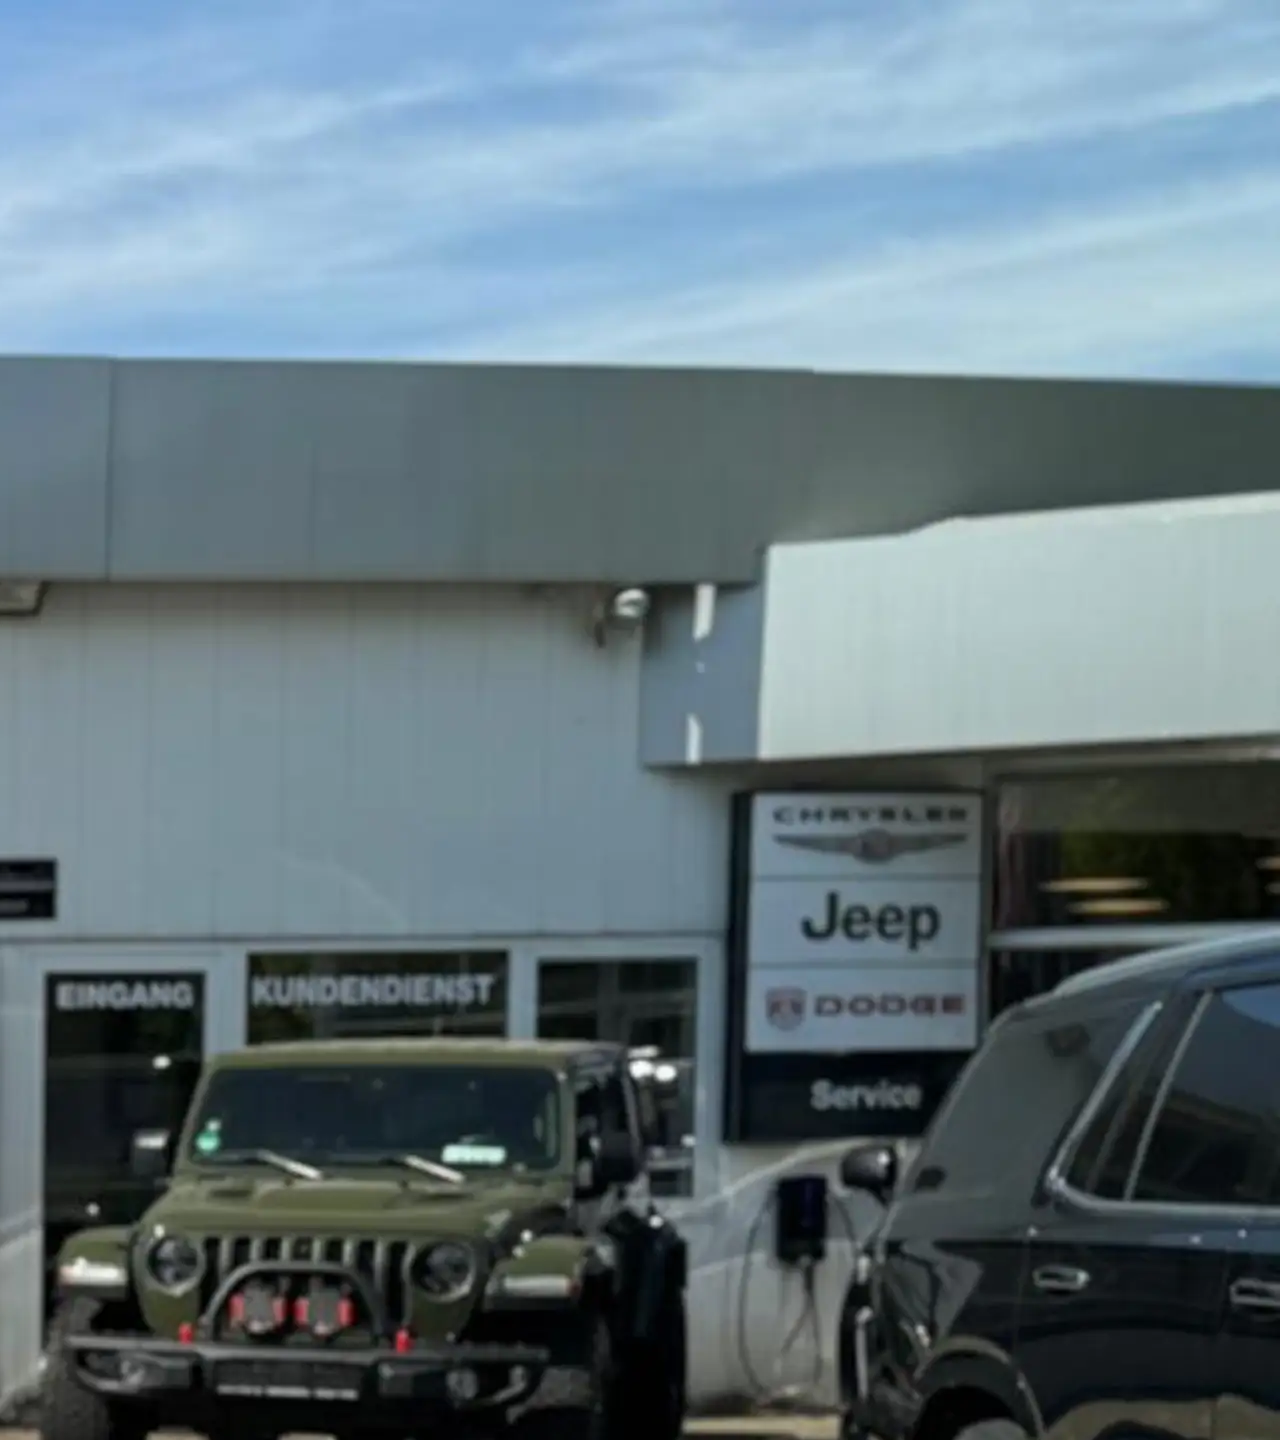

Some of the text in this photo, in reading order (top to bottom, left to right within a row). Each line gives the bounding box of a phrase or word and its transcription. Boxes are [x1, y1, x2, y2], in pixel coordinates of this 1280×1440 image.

[771, 805, 968, 826] CHRYSLER
[800, 890, 942, 953] Jeep
[55, 980, 194, 1011] EINGANG
[251, 973, 496, 1007] KUNDENDIENST
[812, 993, 967, 1018] DODGE
[809, 1078, 923, 1112] Service
